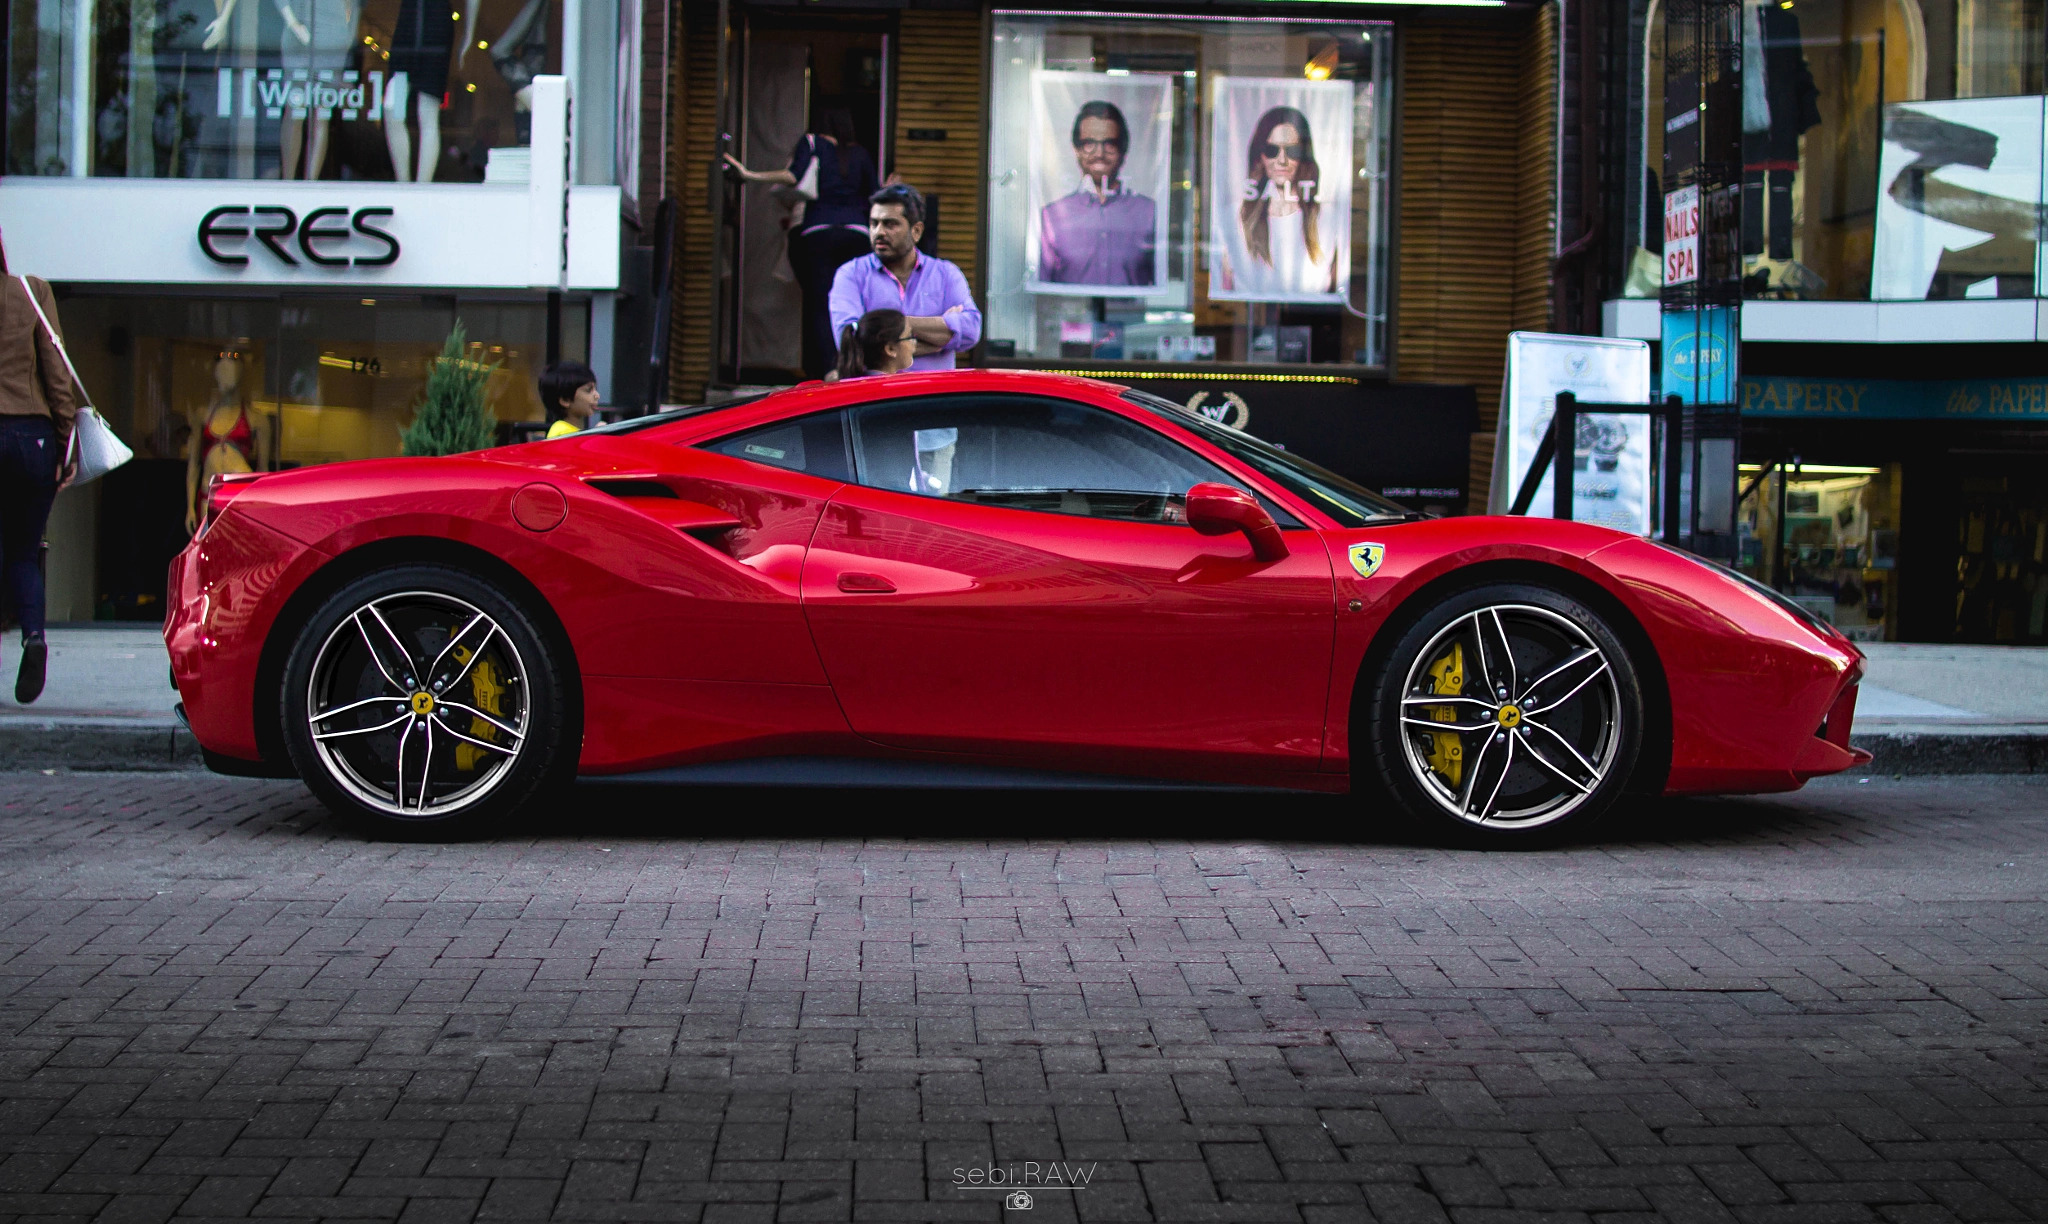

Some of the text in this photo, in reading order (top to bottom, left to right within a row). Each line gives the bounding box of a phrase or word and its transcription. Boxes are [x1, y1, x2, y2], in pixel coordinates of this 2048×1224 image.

[258, 80, 365, 109] Wolford
[198, 205, 401, 267] ERES
[1665, 206, 1698, 243] NAILS
[1668, 248, 1694, 282] SPA
[1690, 348, 1722, 364] PPERY
[1744, 382, 1867, 413] PAPERY
[1946, 384, 2048, 414] the PAPE
